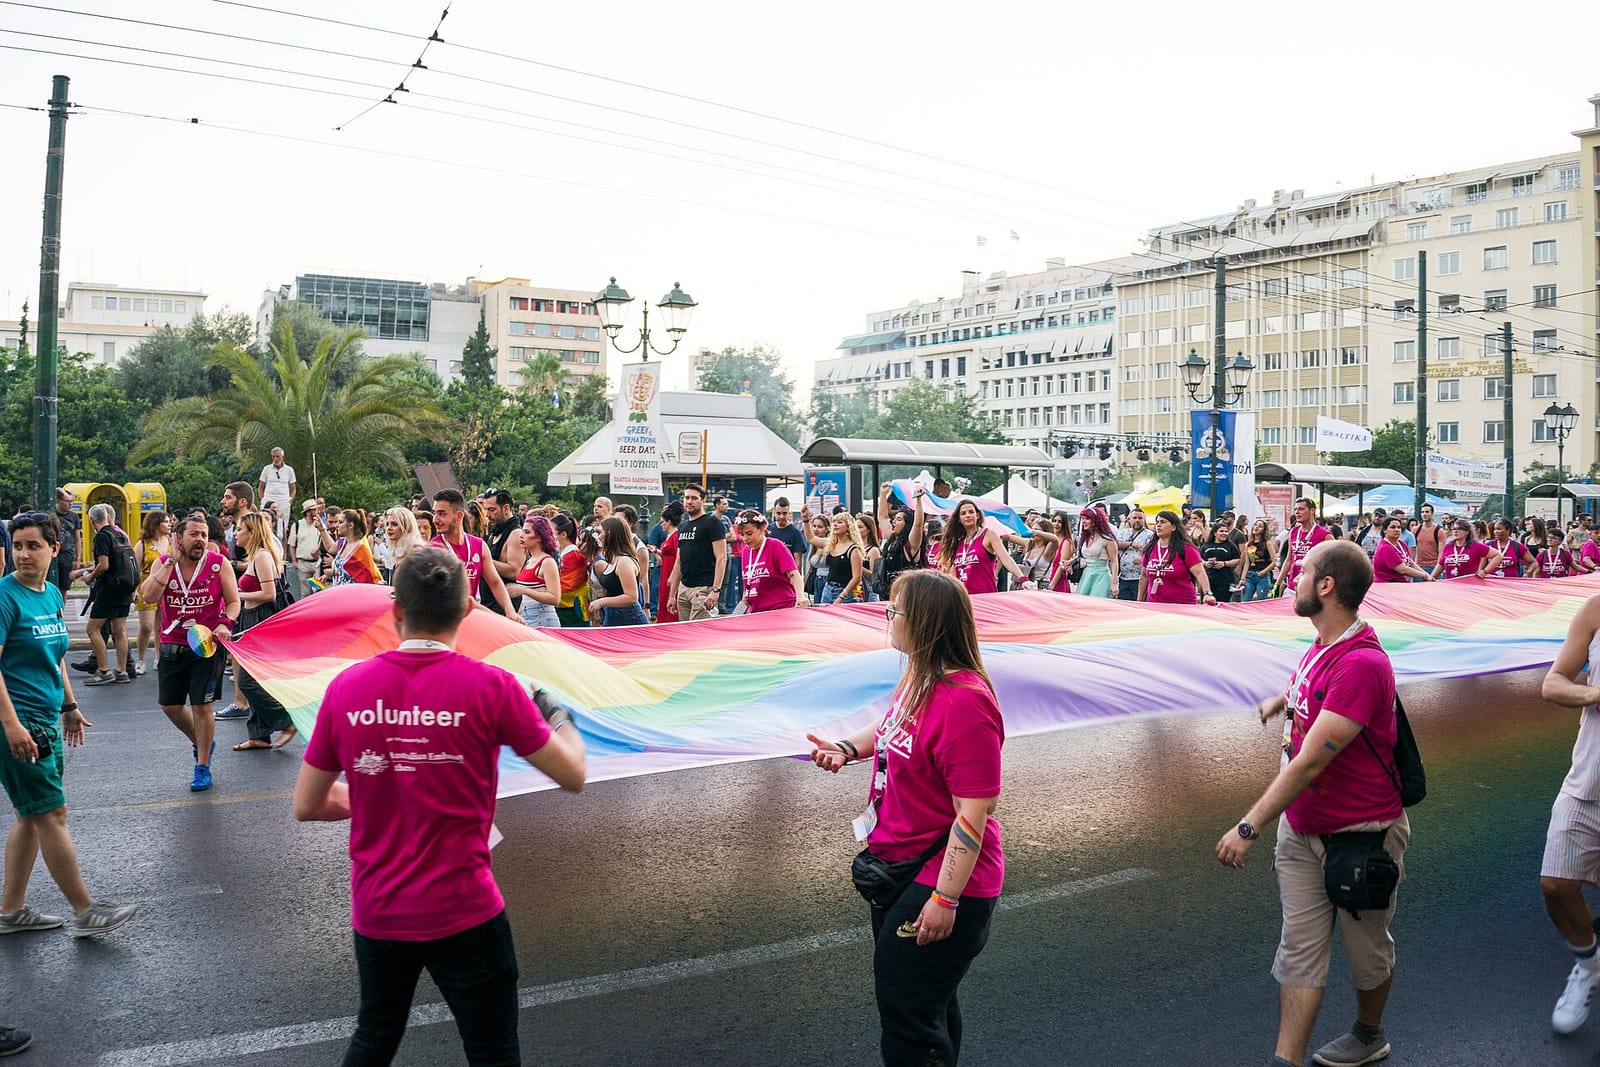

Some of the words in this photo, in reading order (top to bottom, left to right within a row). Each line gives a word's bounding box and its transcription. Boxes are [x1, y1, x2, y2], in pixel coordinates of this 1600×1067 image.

[626, 425, 649, 435] GREEK
[619, 445, 637, 454] BEER
[638, 445, 656, 455] DAYS
[346, 699, 466, 727] volunteer
